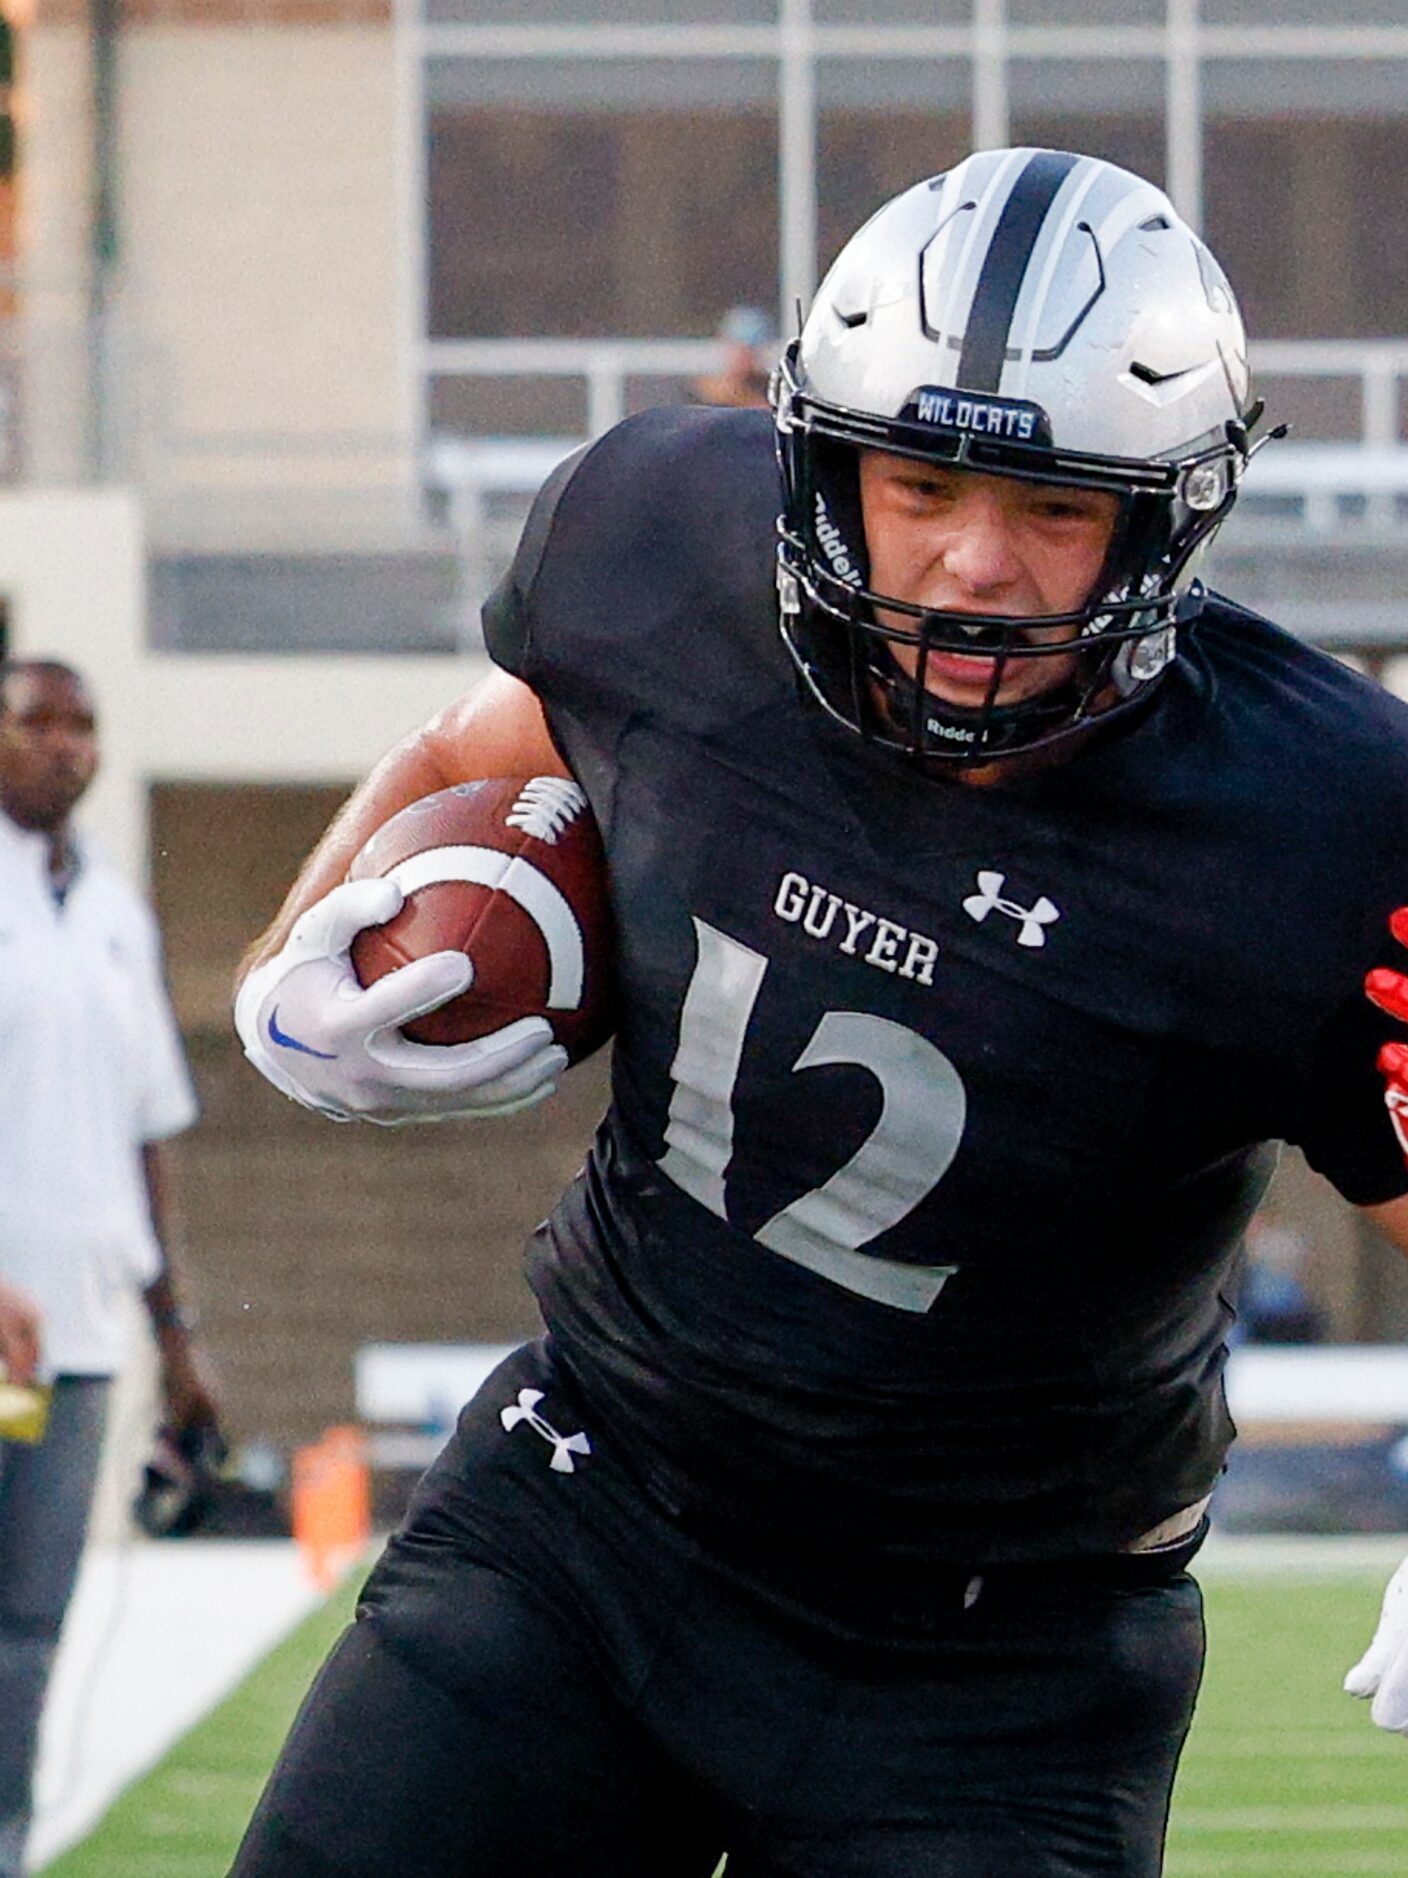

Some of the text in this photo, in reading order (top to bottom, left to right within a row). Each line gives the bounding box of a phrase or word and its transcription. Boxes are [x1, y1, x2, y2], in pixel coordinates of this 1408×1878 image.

[917, 391, 1035, 440] WILDCATS
[926, 717, 989, 743] Riddel
[773, 871, 940, 986] GUYER
[655, 915, 967, 1315] 12
